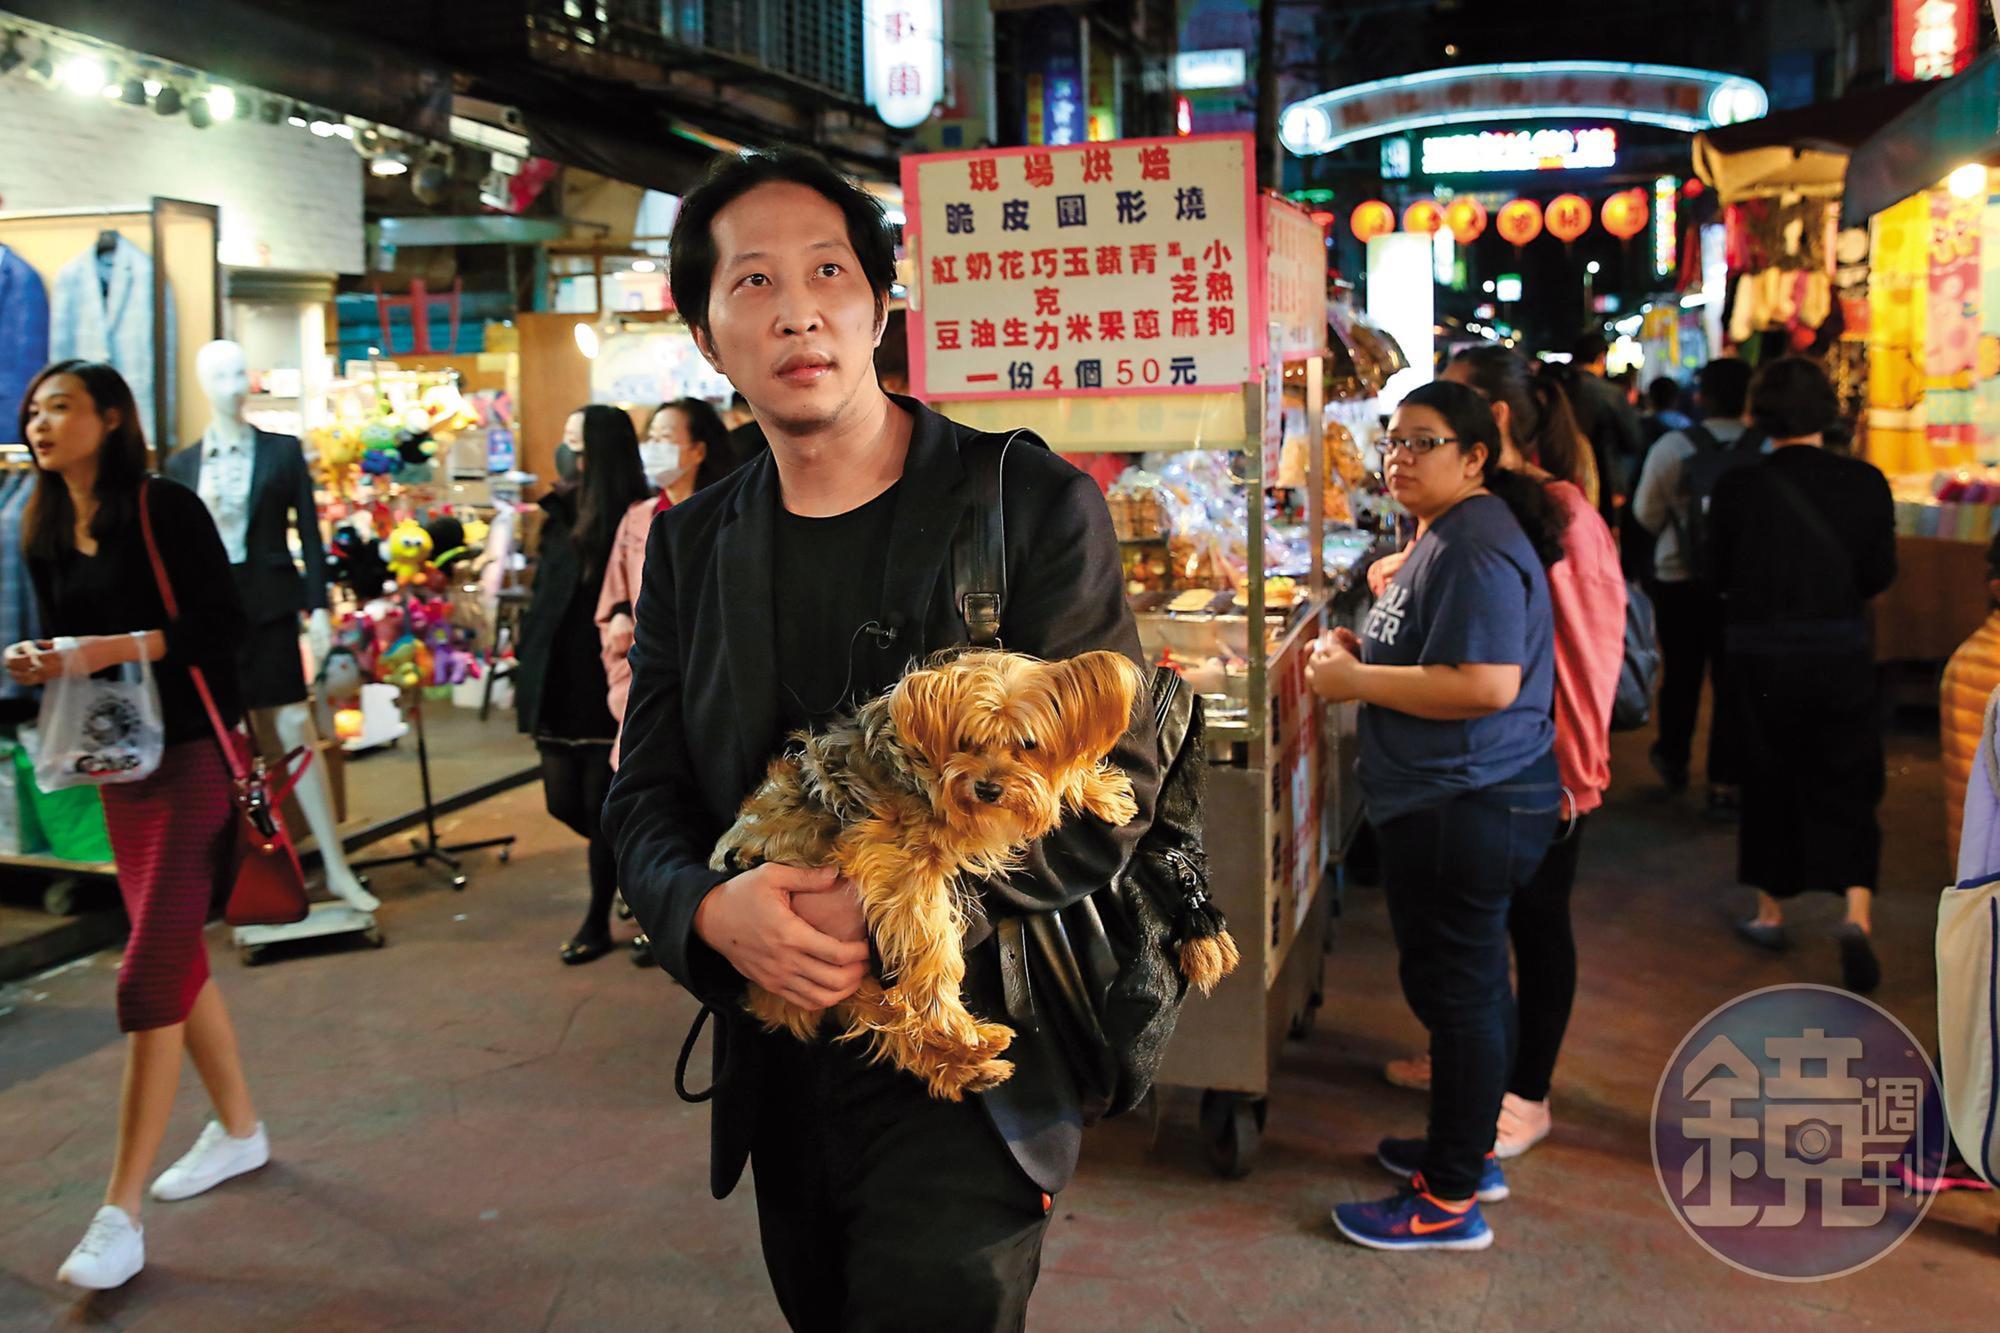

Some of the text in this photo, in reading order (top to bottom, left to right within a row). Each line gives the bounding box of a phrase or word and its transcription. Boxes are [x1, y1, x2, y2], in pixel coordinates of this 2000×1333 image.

[968, 146, 1171, 192] 現場烘焙
[945, 187, 1207, 236] 脆皮圓形燒
[966, 356, 1197, 390] 一份4個50元
